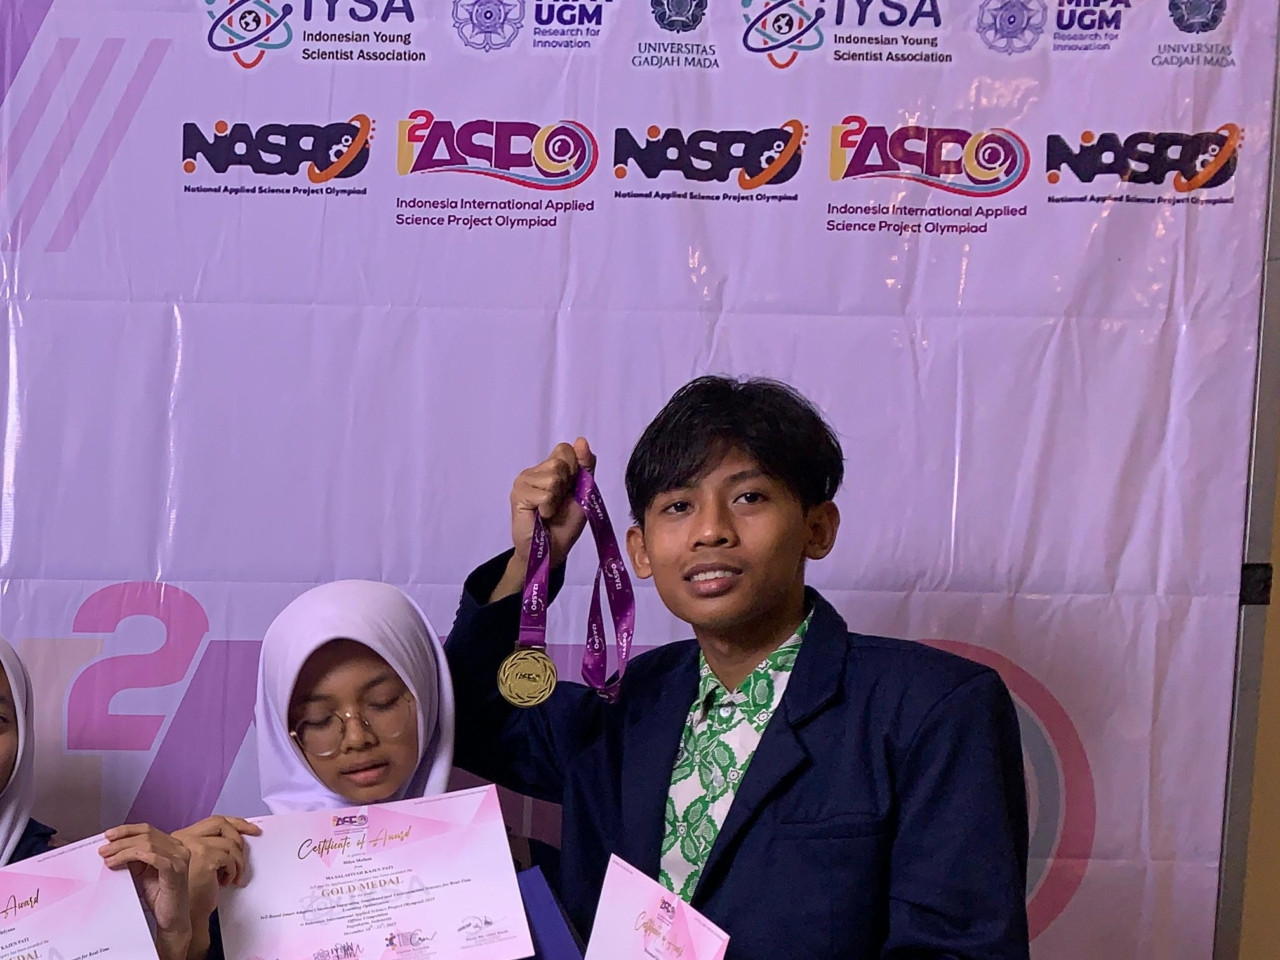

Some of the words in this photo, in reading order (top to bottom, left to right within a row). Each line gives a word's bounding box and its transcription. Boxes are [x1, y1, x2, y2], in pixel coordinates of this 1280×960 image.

[534, 5, 603, 27] UGM
[1056, 10, 1121, 30] UGM
[302, 30, 371, 44] Indonesian
[374, 30, 411, 46] Young
[533, 28, 581, 38] Research
[584, 27, 601, 38] for
[533, 38, 591, 49] Innovation
[637, 42, 716, 56] UNIVERSITAS
[833, 34, 897, 46] Indonesian
[900, 35, 938, 48] Young
[302, 48, 354, 62] Scientist
[356, 48, 426, 62] Association
[631, 54, 682, 69] GADJAH
[684, 56, 720, 70] MADA
[833, 50, 883, 63] Scientist
[886, 51, 952, 63] Association
[183, 184, 219, 194] National
[220, 185, 256, 197] Applied
[258, 186, 291, 196] Science
[292, 186, 324, 198] Project
[325, 186, 368, 198] Olympiad
[614, 190, 652, 200] National
[654, 191, 688, 202] Applied
[689, 192, 721, 202] Science
[722, 193, 754, 204] Project
[756, 194, 799, 205] Olympiad
[396, 197, 458, 211] Indonesia
[460, 198, 543, 212] International
[545, 199, 595, 215] Applied
[827, 203, 889, 216] Indonesia
[891, 204, 973, 218] International
[975, 205, 1028, 221] Applied
[396, 213, 445, 227] Science
[448, 214, 494, 230] Project
[496, 214, 557, 230] Olympiad
[826, 220, 876, 234] Science
[878, 221, 922, 237] Project
[925, 221, 988, 237] Olympiad
[297, 836, 351, 860] Certificate
[321, 885, 356, 898] GOLD
[360, 876, 404, 891] MEDAL
[0, 888, 40, 919] Award
